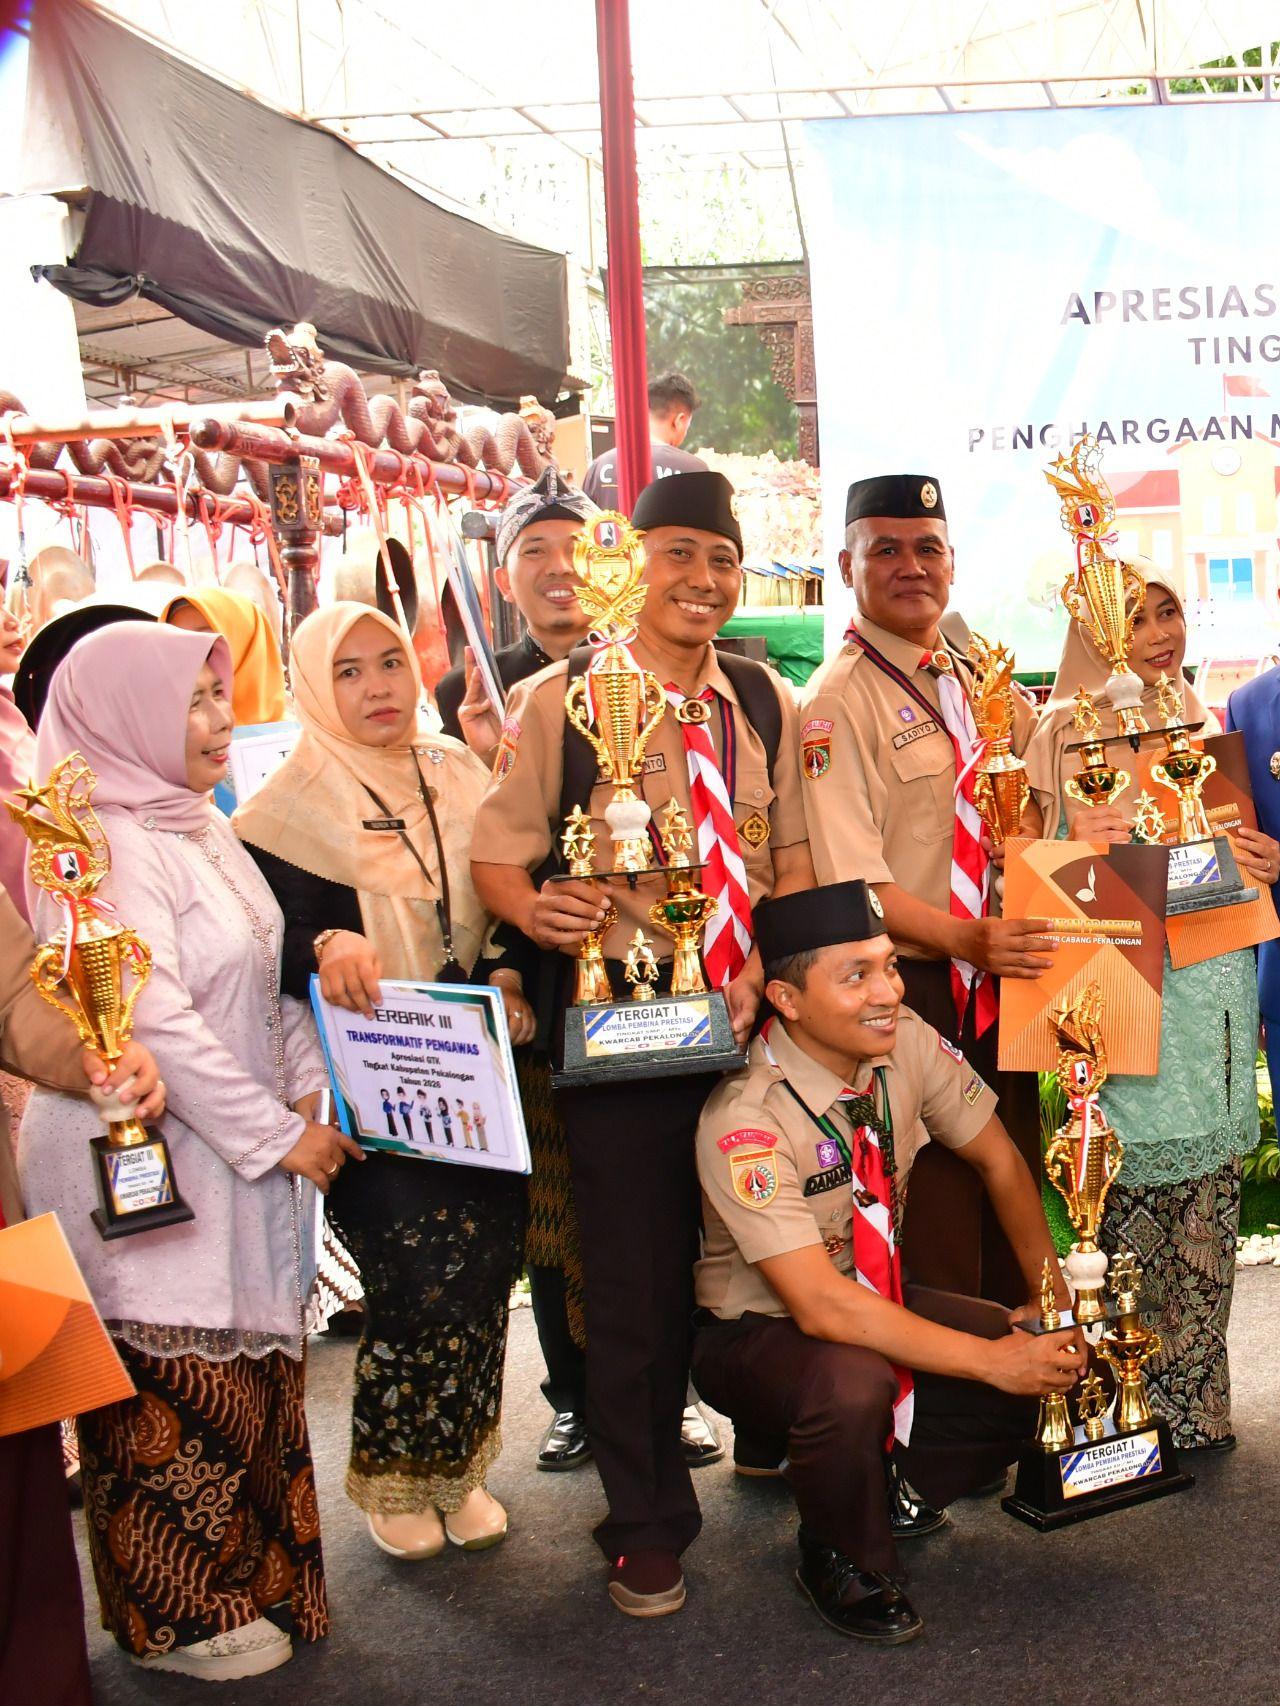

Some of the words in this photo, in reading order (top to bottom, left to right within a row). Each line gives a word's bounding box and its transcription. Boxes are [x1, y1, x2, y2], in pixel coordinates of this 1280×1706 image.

[967, 414, 1253, 453] PENGHARGAAN
[900, 724, 932, 743] SADIYO
[644, 758, 664, 770] NTO
[1212, 818, 1243, 832] EKALONGAN
[1060, 935, 1092, 945] CABANG
[1092, 936, 1142, 946] PEKALONGAN
[374, 1008, 436, 1028] ERBAIK
[438, 1014, 453, 1030] III
[615, 1006, 670, 1022] TERGIAT
[674, 1005, 679, 1017] I
[628, 1020, 660, 1030] PEMBINA
[660, 1017, 694, 1026] PRESTASI
[346, 1029, 424, 1050] TRANSFORMATIF
[425, 1038, 480, 1056] PENGAWAS
[598, 1037, 641, 1046] KWARCAB
[390, 1064, 430, 1076] Kabupaten
[431, 1068, 475, 1082] Pekalongan
[1085, 1441, 1128, 1461] TERGIAT
[1131, 1439, 1135, 1450] I
[1095, 1455, 1121, 1467] PEMBINA
[1120, 1447, 1147, 1460] PRESTASI
